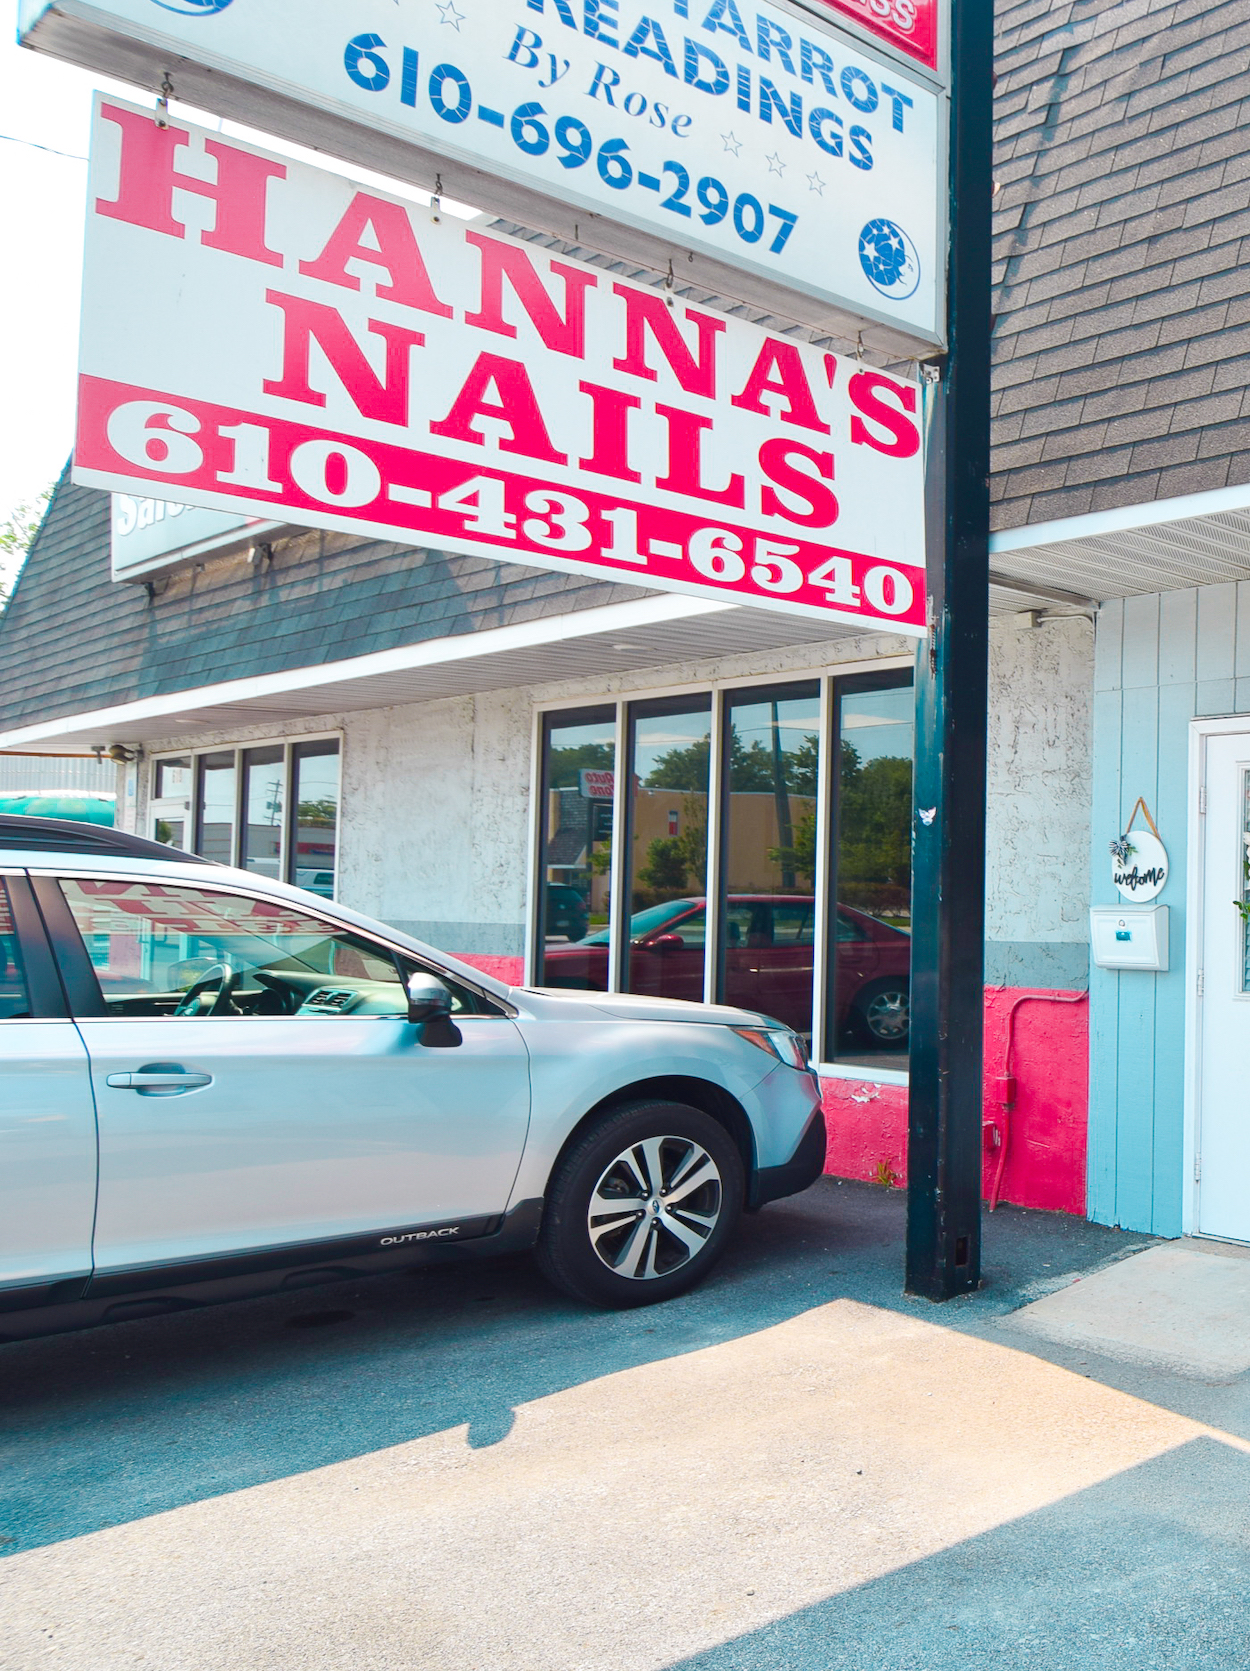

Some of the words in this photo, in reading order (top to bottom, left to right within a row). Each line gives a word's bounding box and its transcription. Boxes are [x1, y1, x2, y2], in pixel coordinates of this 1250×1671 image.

[343, 33, 799, 255] 610-696-2907
[502, 23, 570, 88] By
[584, 60, 693, 138] Rose
[95, 102, 922, 459] HANNA'S
[106, 400, 914, 616] 610-431-6540
[263, 289, 839, 529] NAILS
[1114, 866, 1165, 891] welcome
[380, 1226, 460, 1246] OUTBACK
